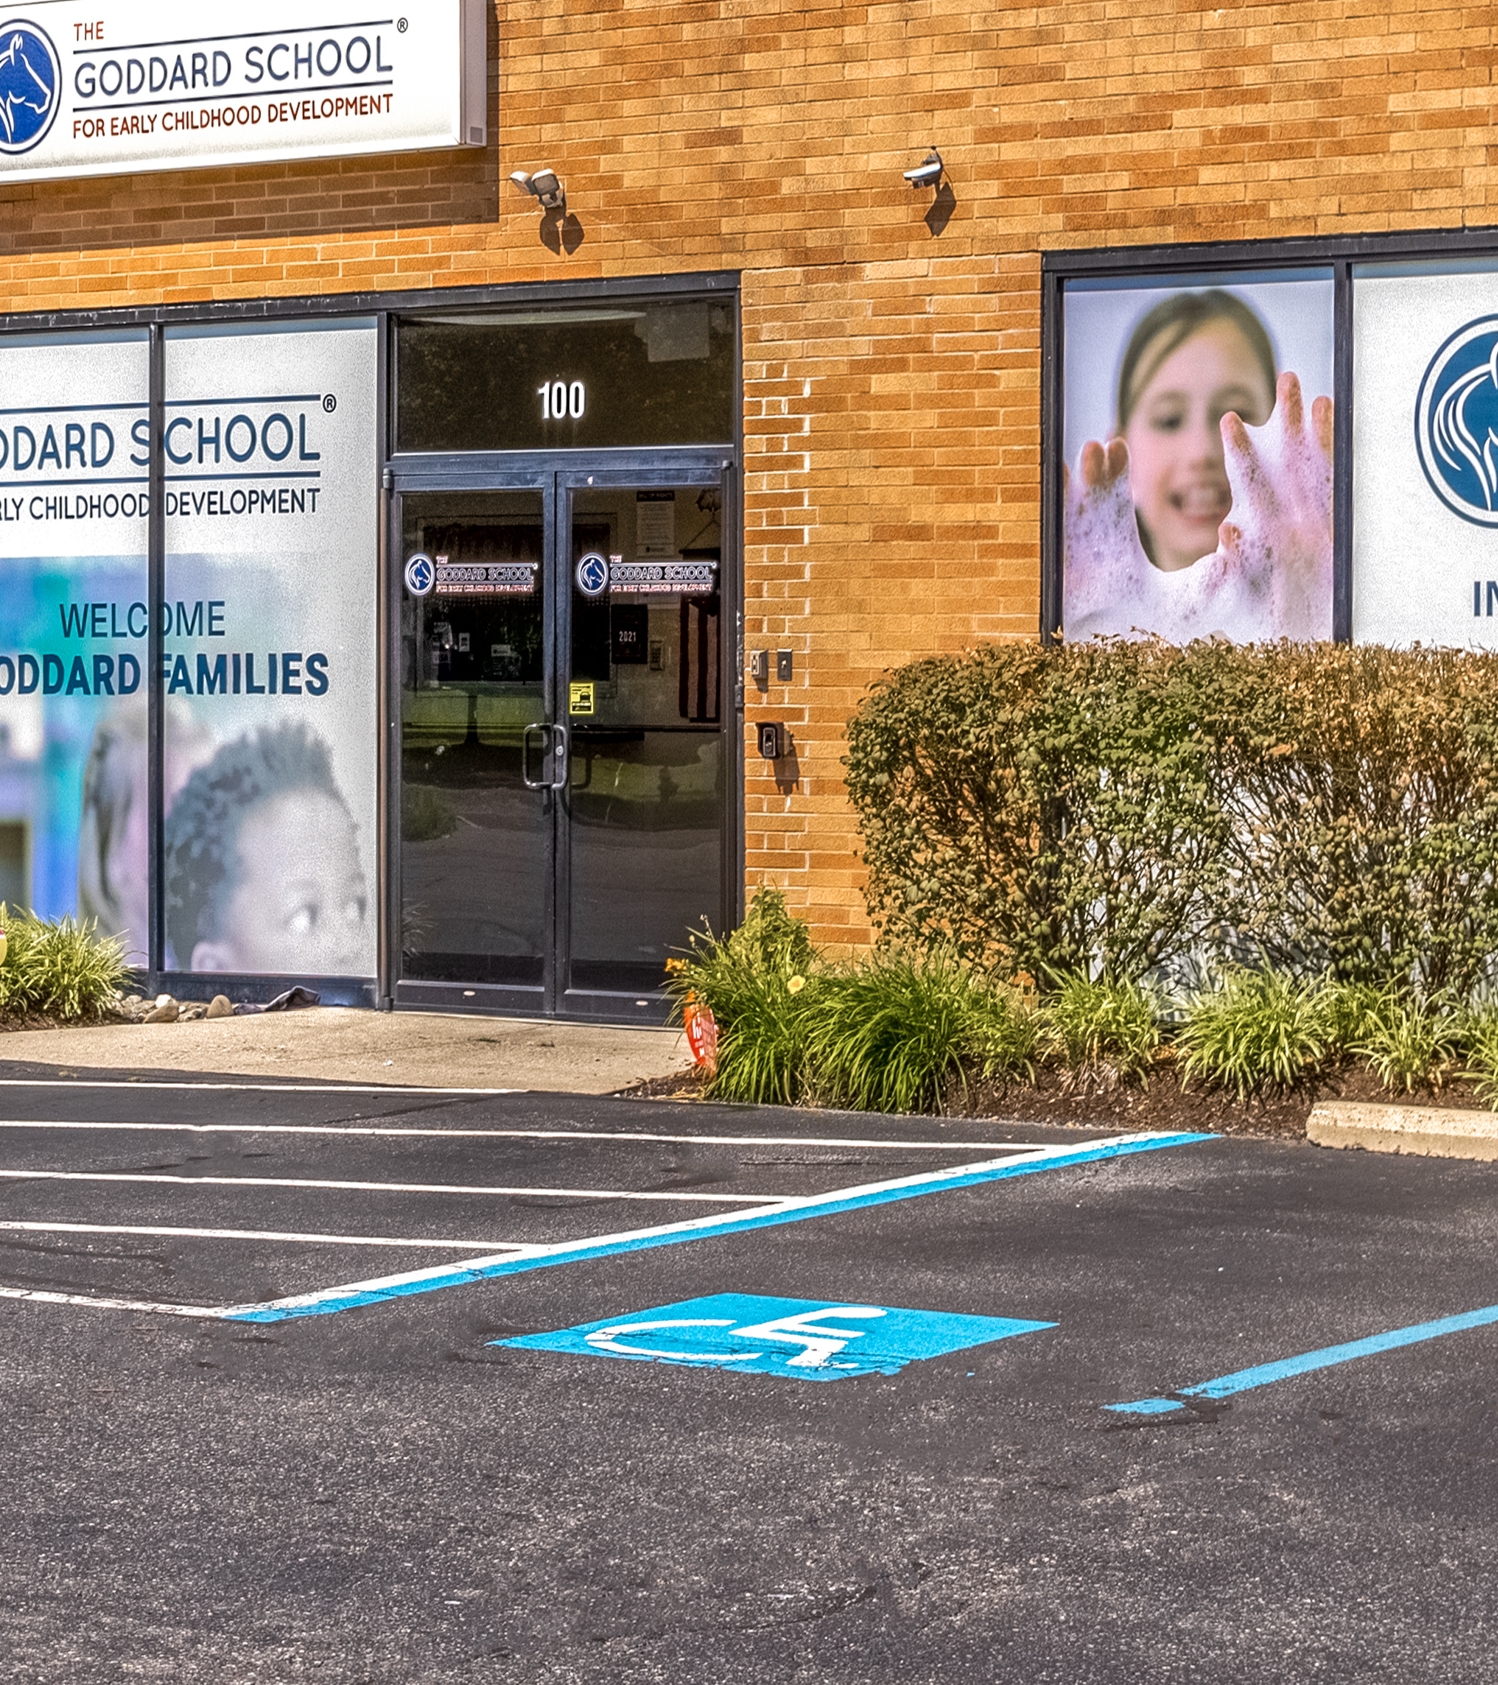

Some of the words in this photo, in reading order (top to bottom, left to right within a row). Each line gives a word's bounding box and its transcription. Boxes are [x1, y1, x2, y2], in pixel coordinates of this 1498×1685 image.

[73, 21, 105, 42] THE
[74, 50, 232, 99] GODDARD
[73, 118, 105, 139] FOR
[110, 114, 157, 137] EARLY
[161, 104, 262, 132] CHILDHOOD
[267, 93, 393, 123] DEVELOPMENT
[537, 380, 585, 419] 100
[29, 493, 151, 520] CHILDHOOD
[165, 487, 321, 517] DEVELOPMENT
[436, 567, 486, 581] GODDARD
[610, 567, 663, 580] GODDARD
[619, 630, 636, 642] 2021
[162, 652, 330, 696] FAMILIES
